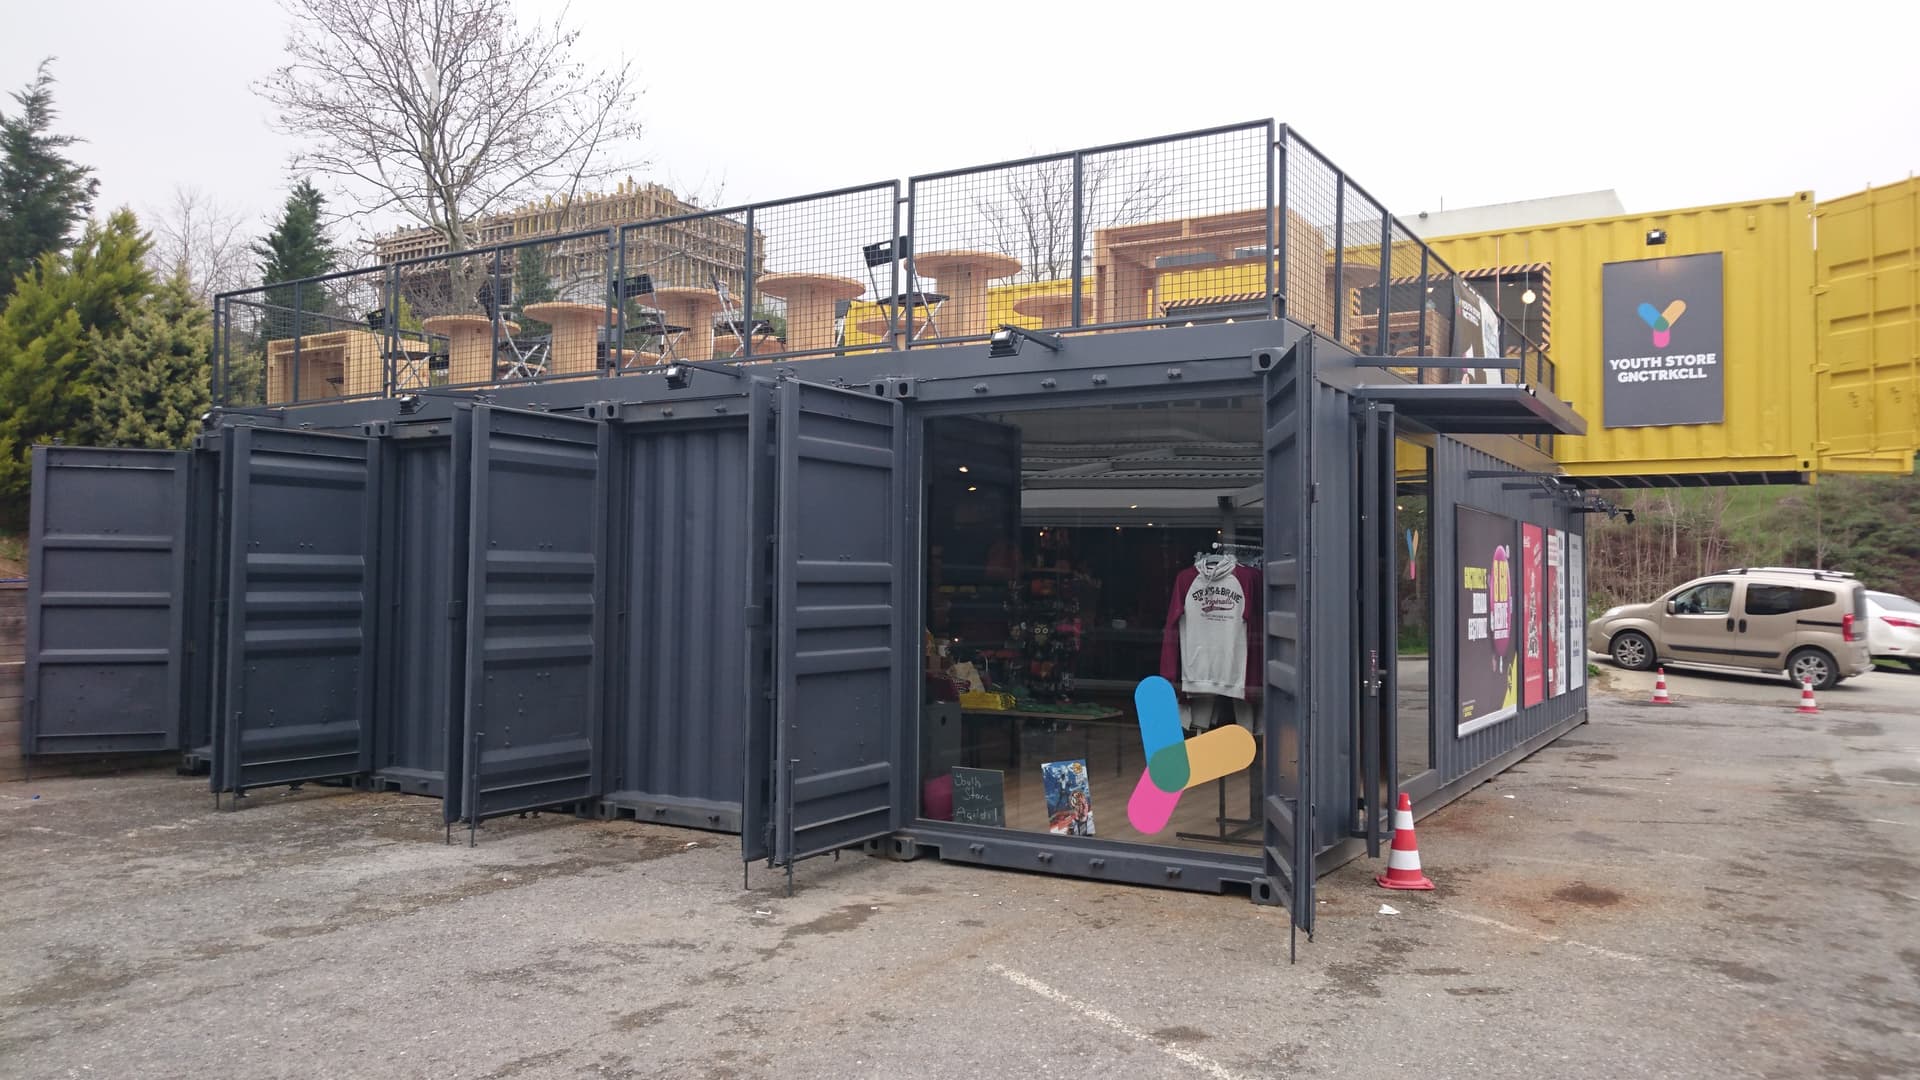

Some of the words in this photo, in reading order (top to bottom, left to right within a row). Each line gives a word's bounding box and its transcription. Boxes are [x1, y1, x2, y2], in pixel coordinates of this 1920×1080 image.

[1609, 356, 1662, 370] YOUTH
[1665, 353, 1717, 367] STORE
[1617, 368, 1707, 383] GNÇTRKCLL
